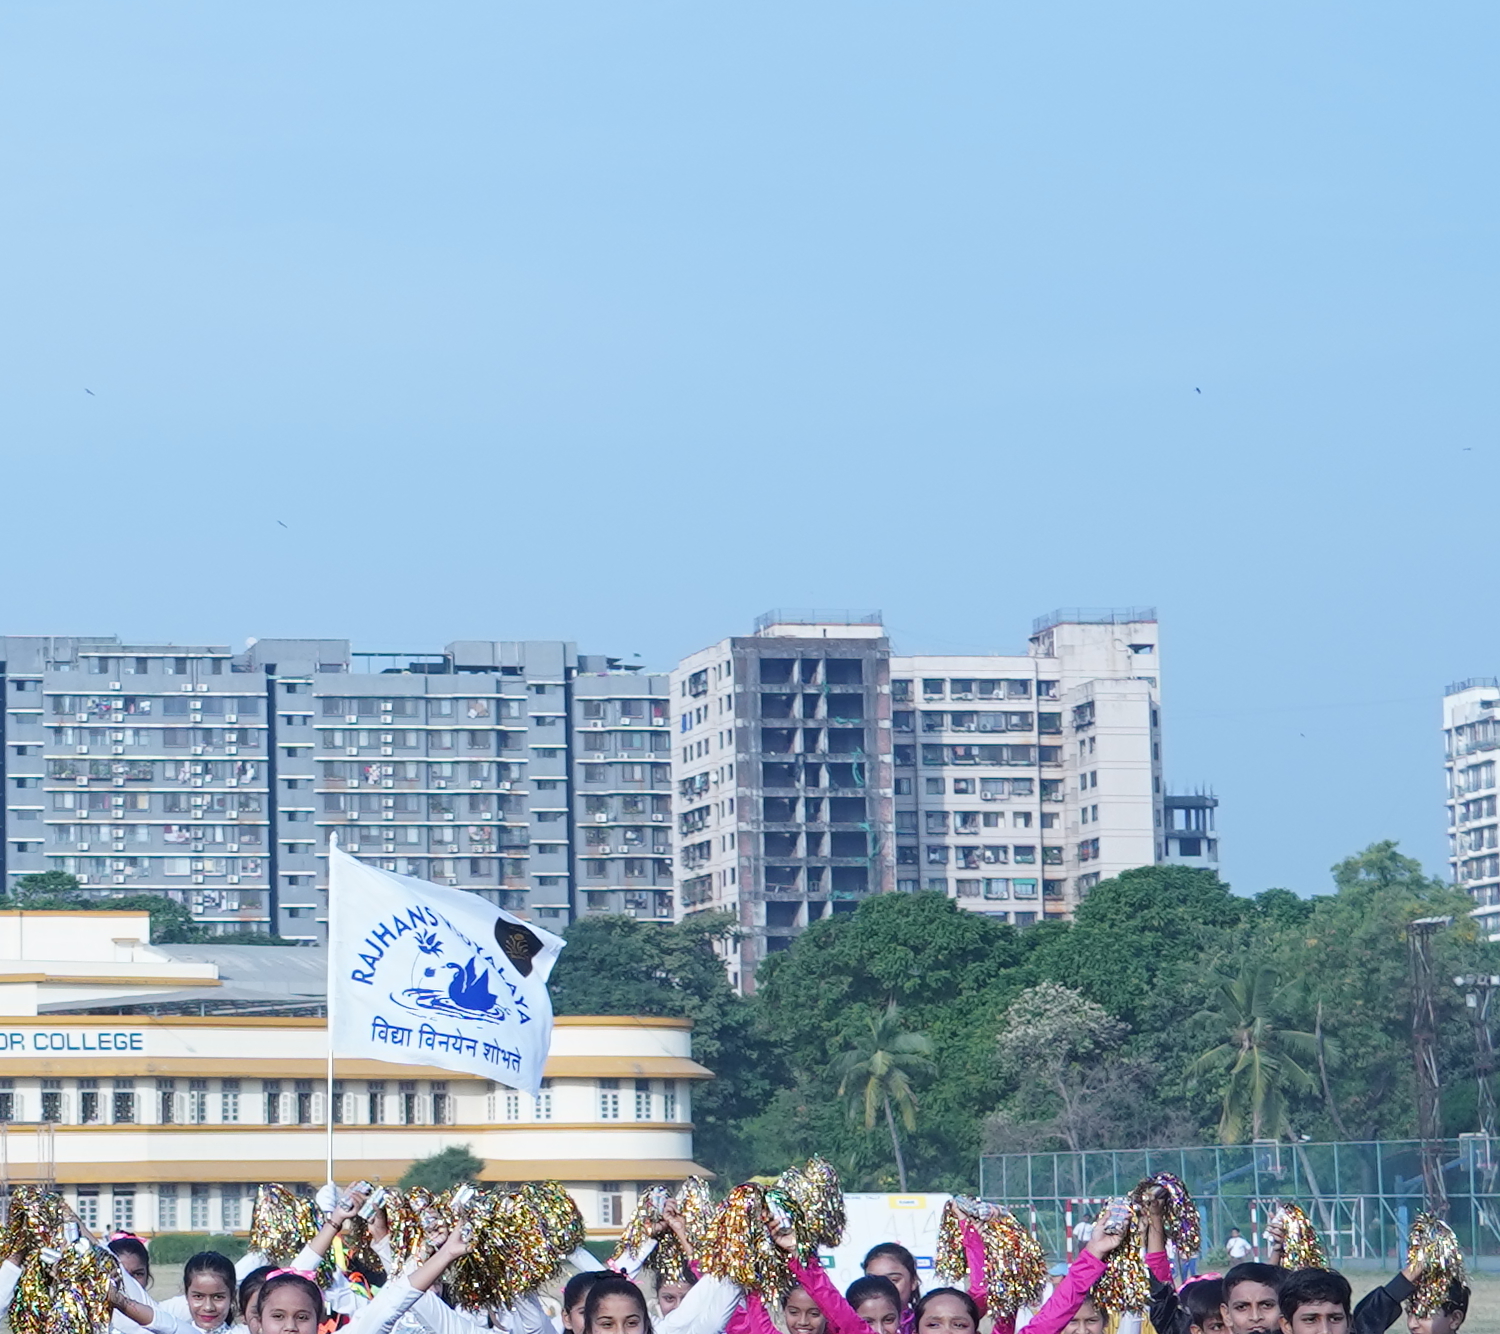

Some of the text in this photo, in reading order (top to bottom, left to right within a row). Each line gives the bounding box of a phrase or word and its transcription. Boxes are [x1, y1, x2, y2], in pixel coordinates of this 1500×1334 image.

[351, 905, 439, 986] RAJHANS
[33, 1032, 144, 1051] COLLEGE
[371, 1015, 522, 1073] विद्या विनयेन शोभते
